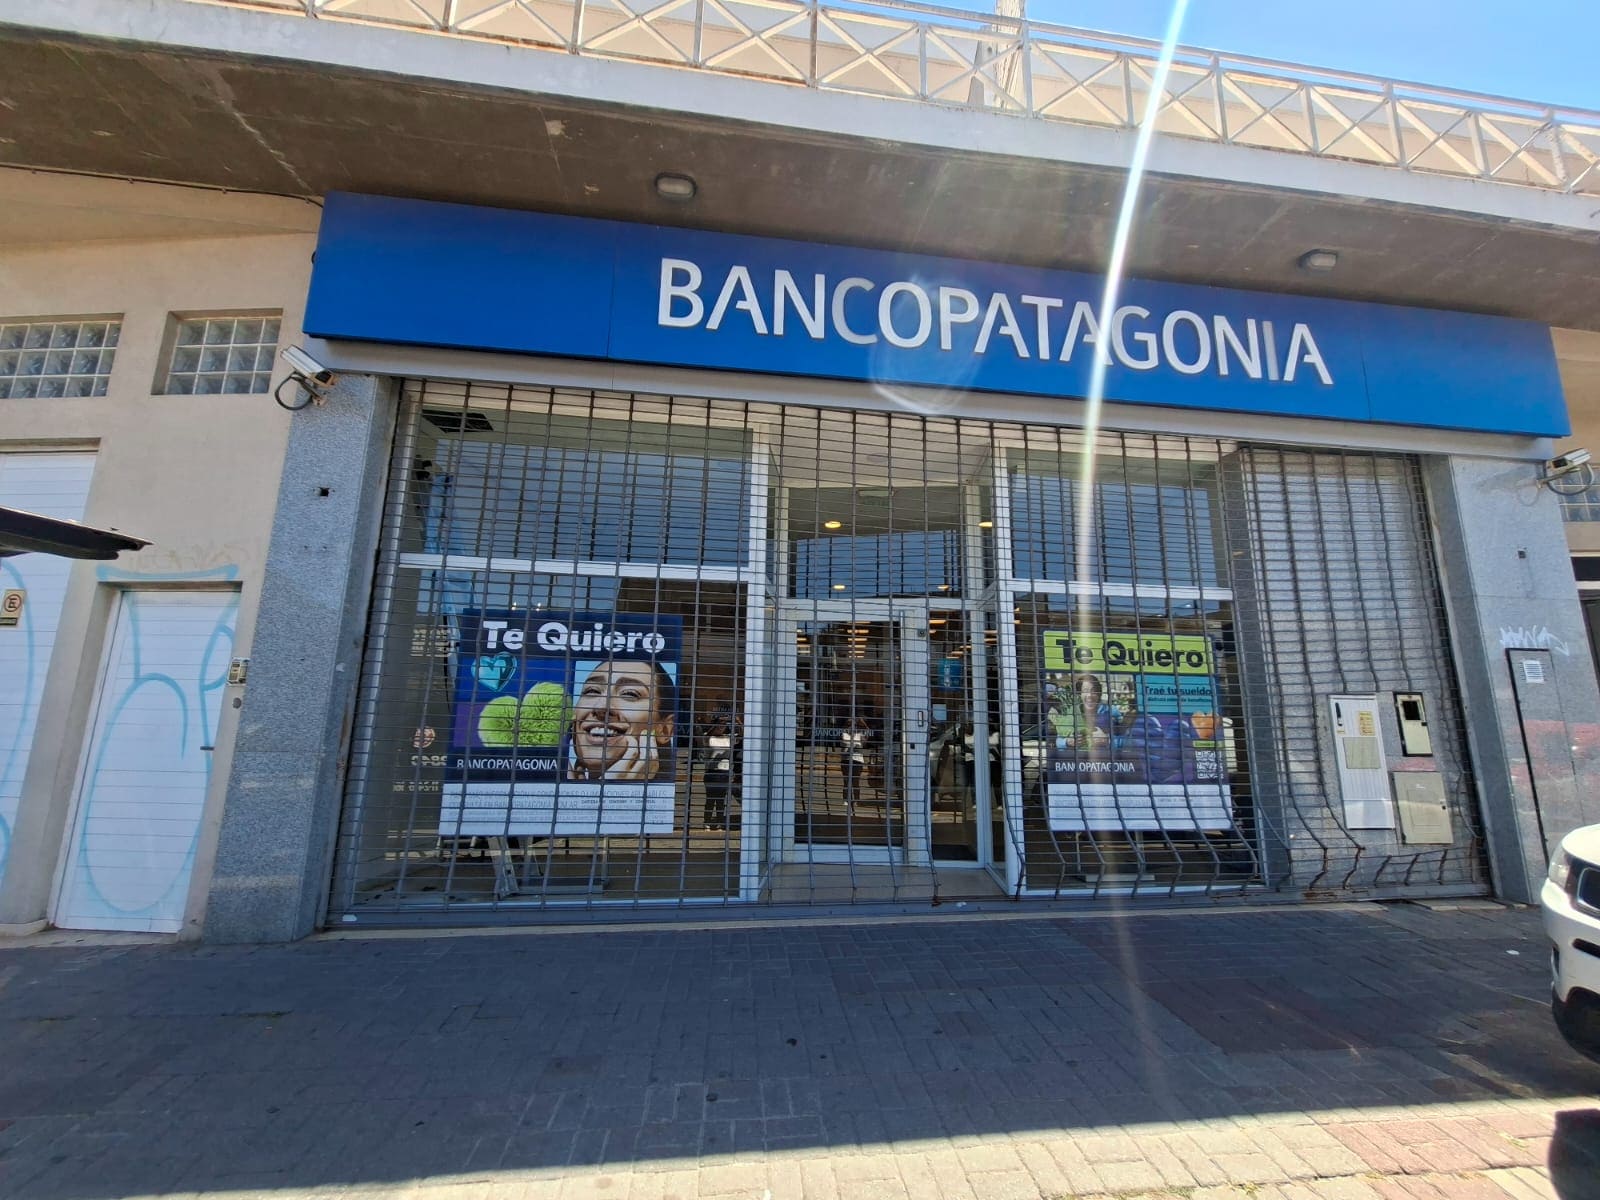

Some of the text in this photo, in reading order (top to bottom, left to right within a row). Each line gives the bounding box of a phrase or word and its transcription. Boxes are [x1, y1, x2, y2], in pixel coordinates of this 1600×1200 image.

[658, 258, 1333, 386] BANCOPATAGONIA
[483, 620, 524, 650] Te
[536, 621, 665, 654] Quiero
[1056, 639, 1204, 668] Te Quiero
[1055, 762, 1135, 772] BANOPATAGONIA
